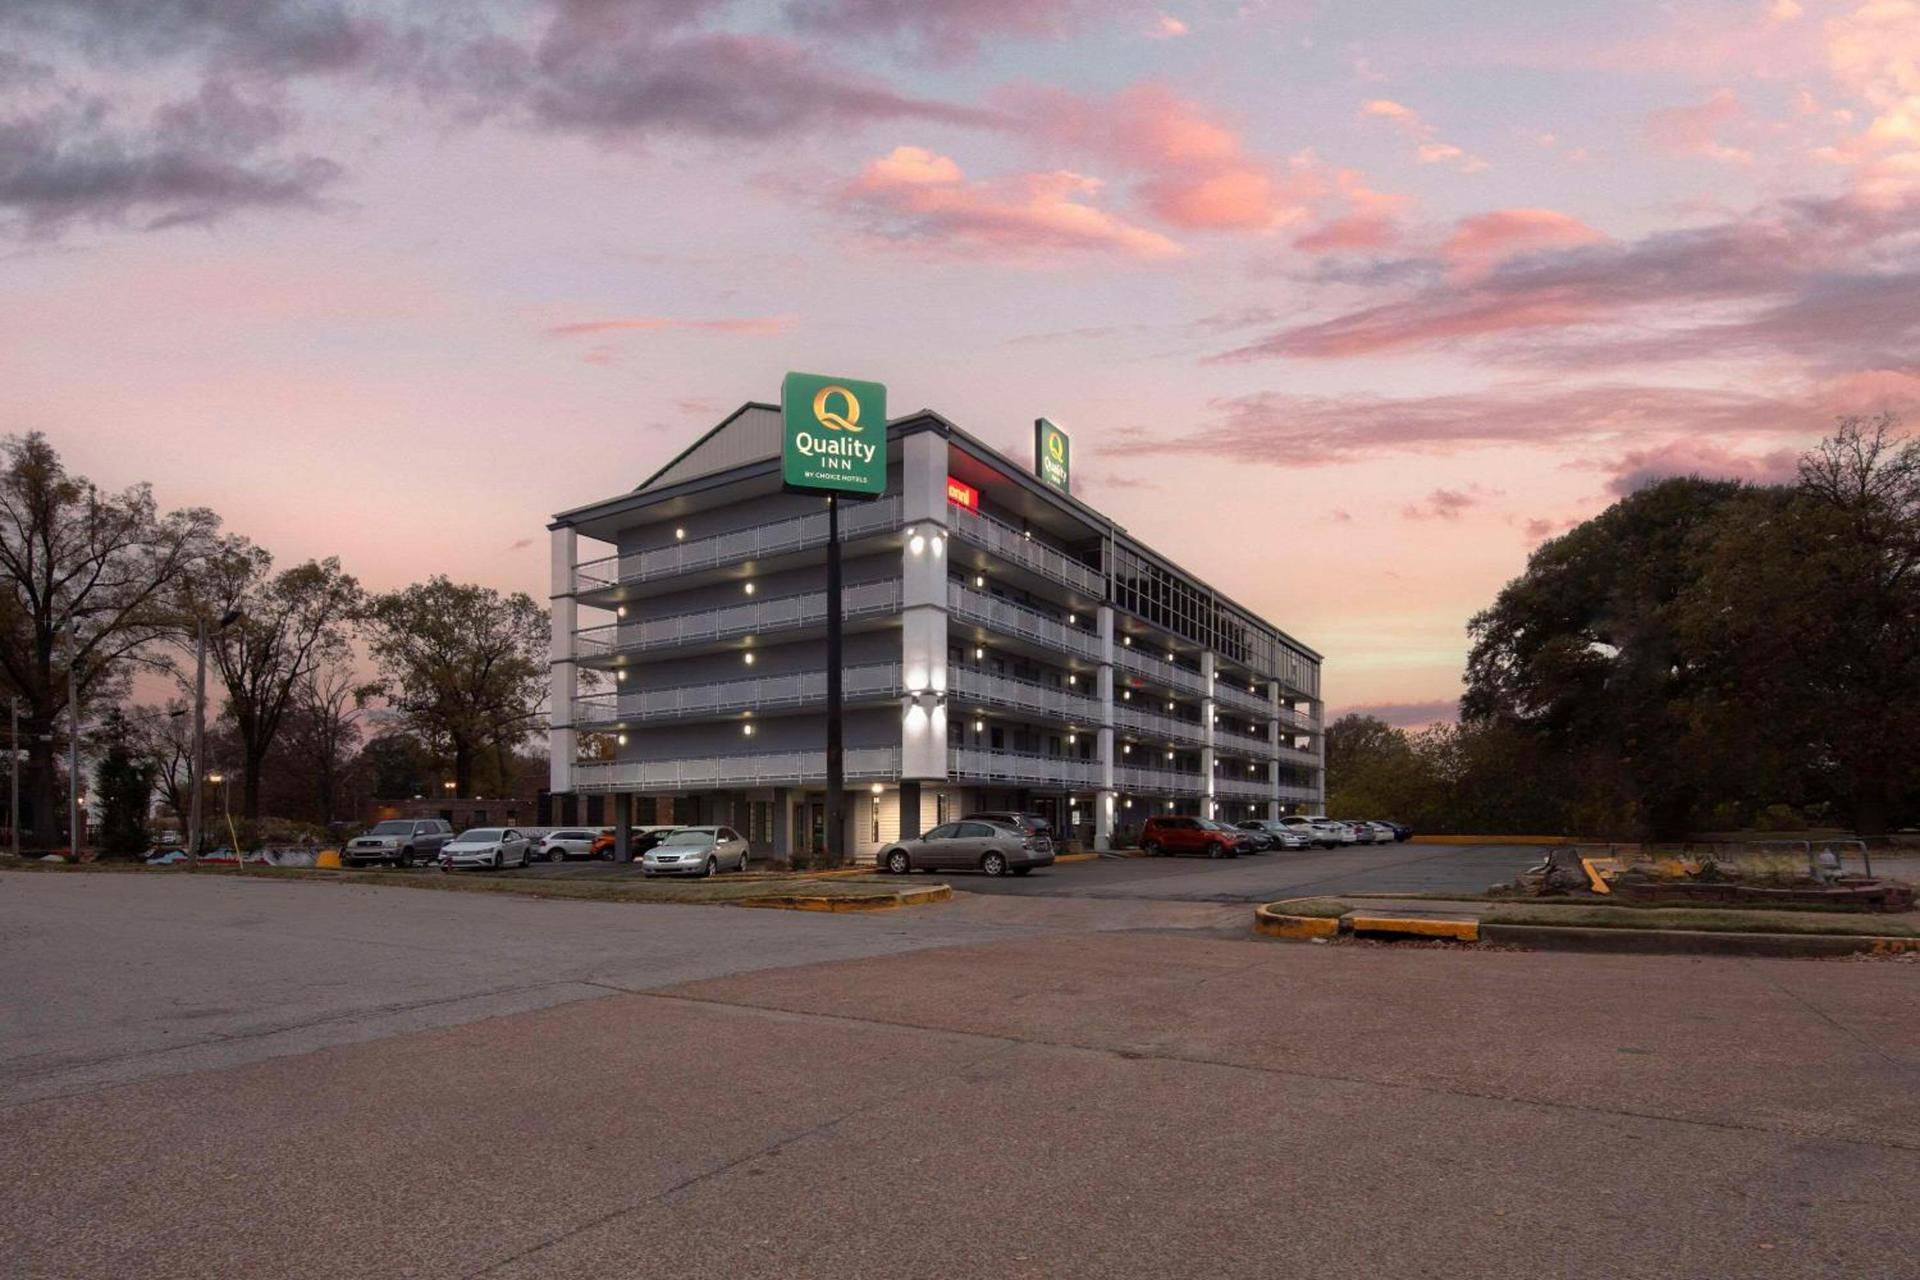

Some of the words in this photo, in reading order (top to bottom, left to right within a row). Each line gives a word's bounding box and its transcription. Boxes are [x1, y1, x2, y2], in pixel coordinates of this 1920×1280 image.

[813, 384, 863, 432] Q
[795, 431, 876, 463] Quality
[821, 457, 851, 470] INN
[815, 472, 841, 481] CHOICE
[841, 474, 868, 484] HOTELS
